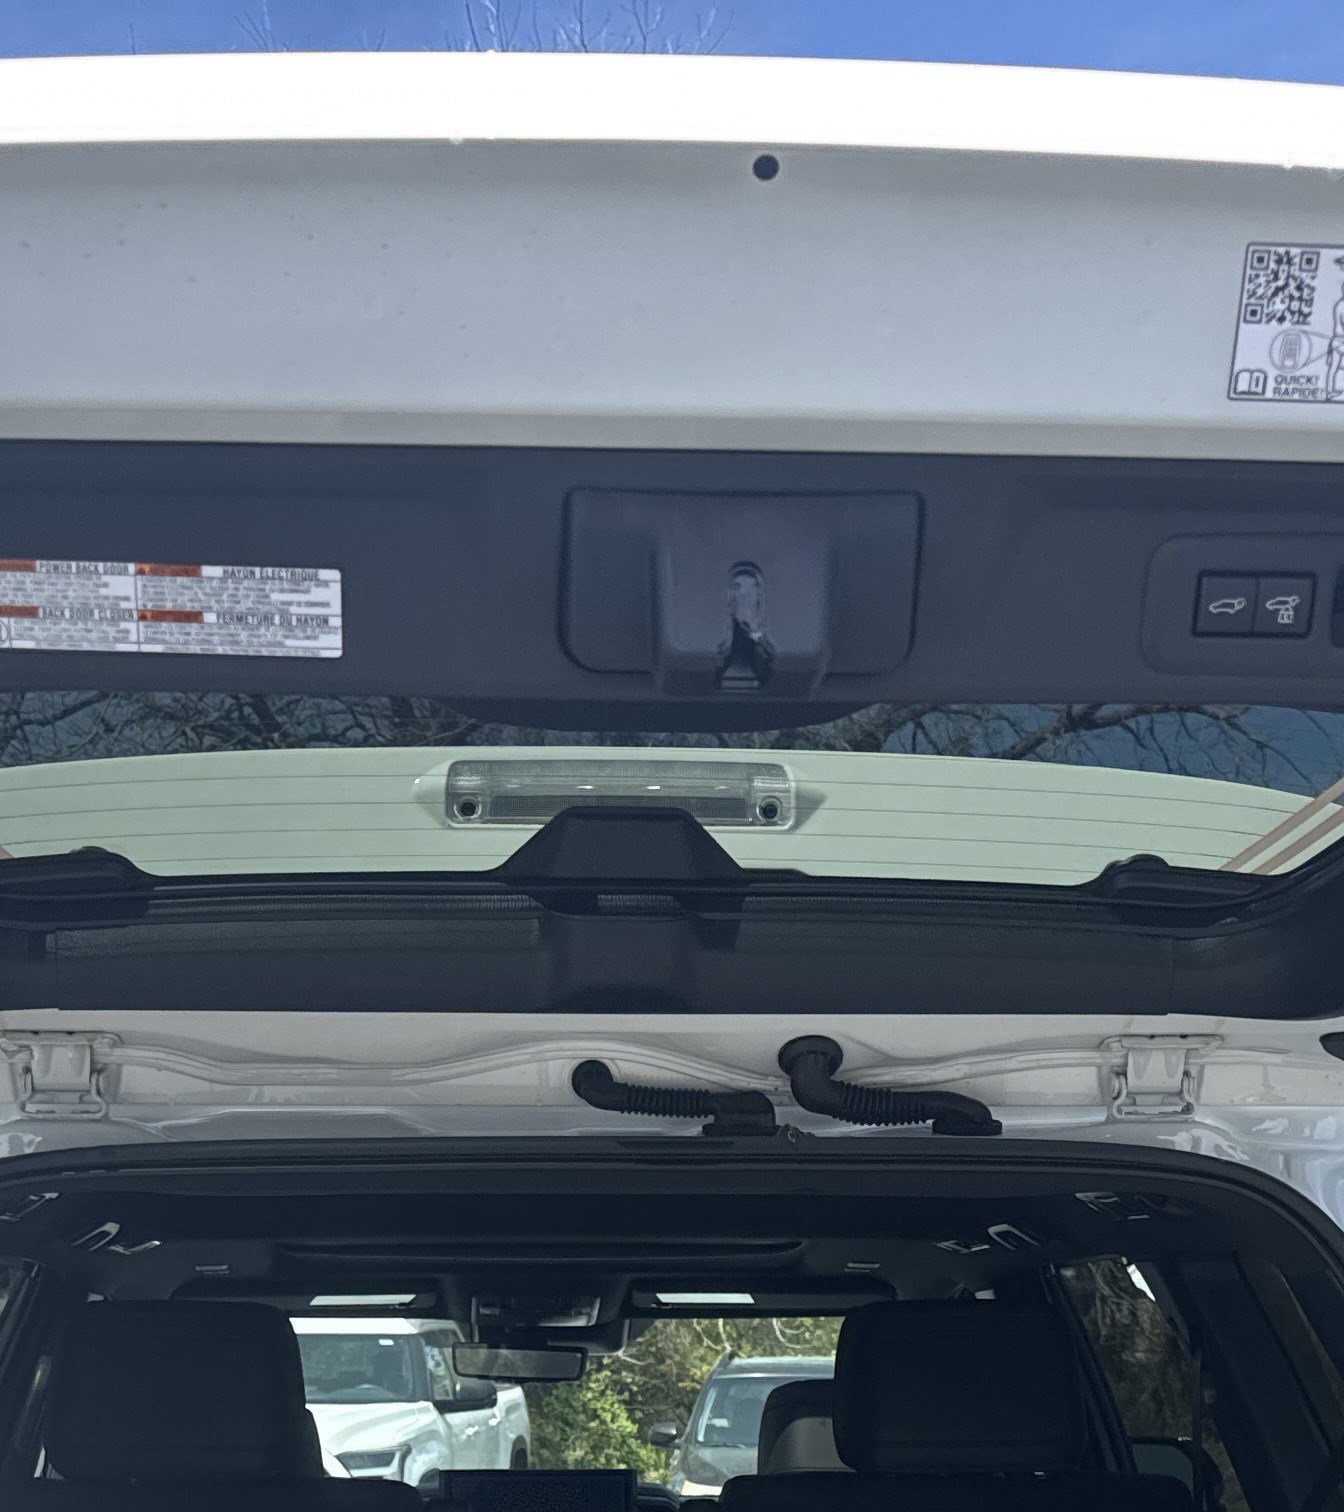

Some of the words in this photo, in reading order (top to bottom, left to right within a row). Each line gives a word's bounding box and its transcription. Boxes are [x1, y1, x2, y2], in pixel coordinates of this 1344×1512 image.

[38, 562, 72, 573] POWER
[76, 562, 99, 573] BACK
[103, 563, 129, 574] DOOR
[223, 567, 256, 579] HAYON
[296, 615, 329, 627] HAYON
